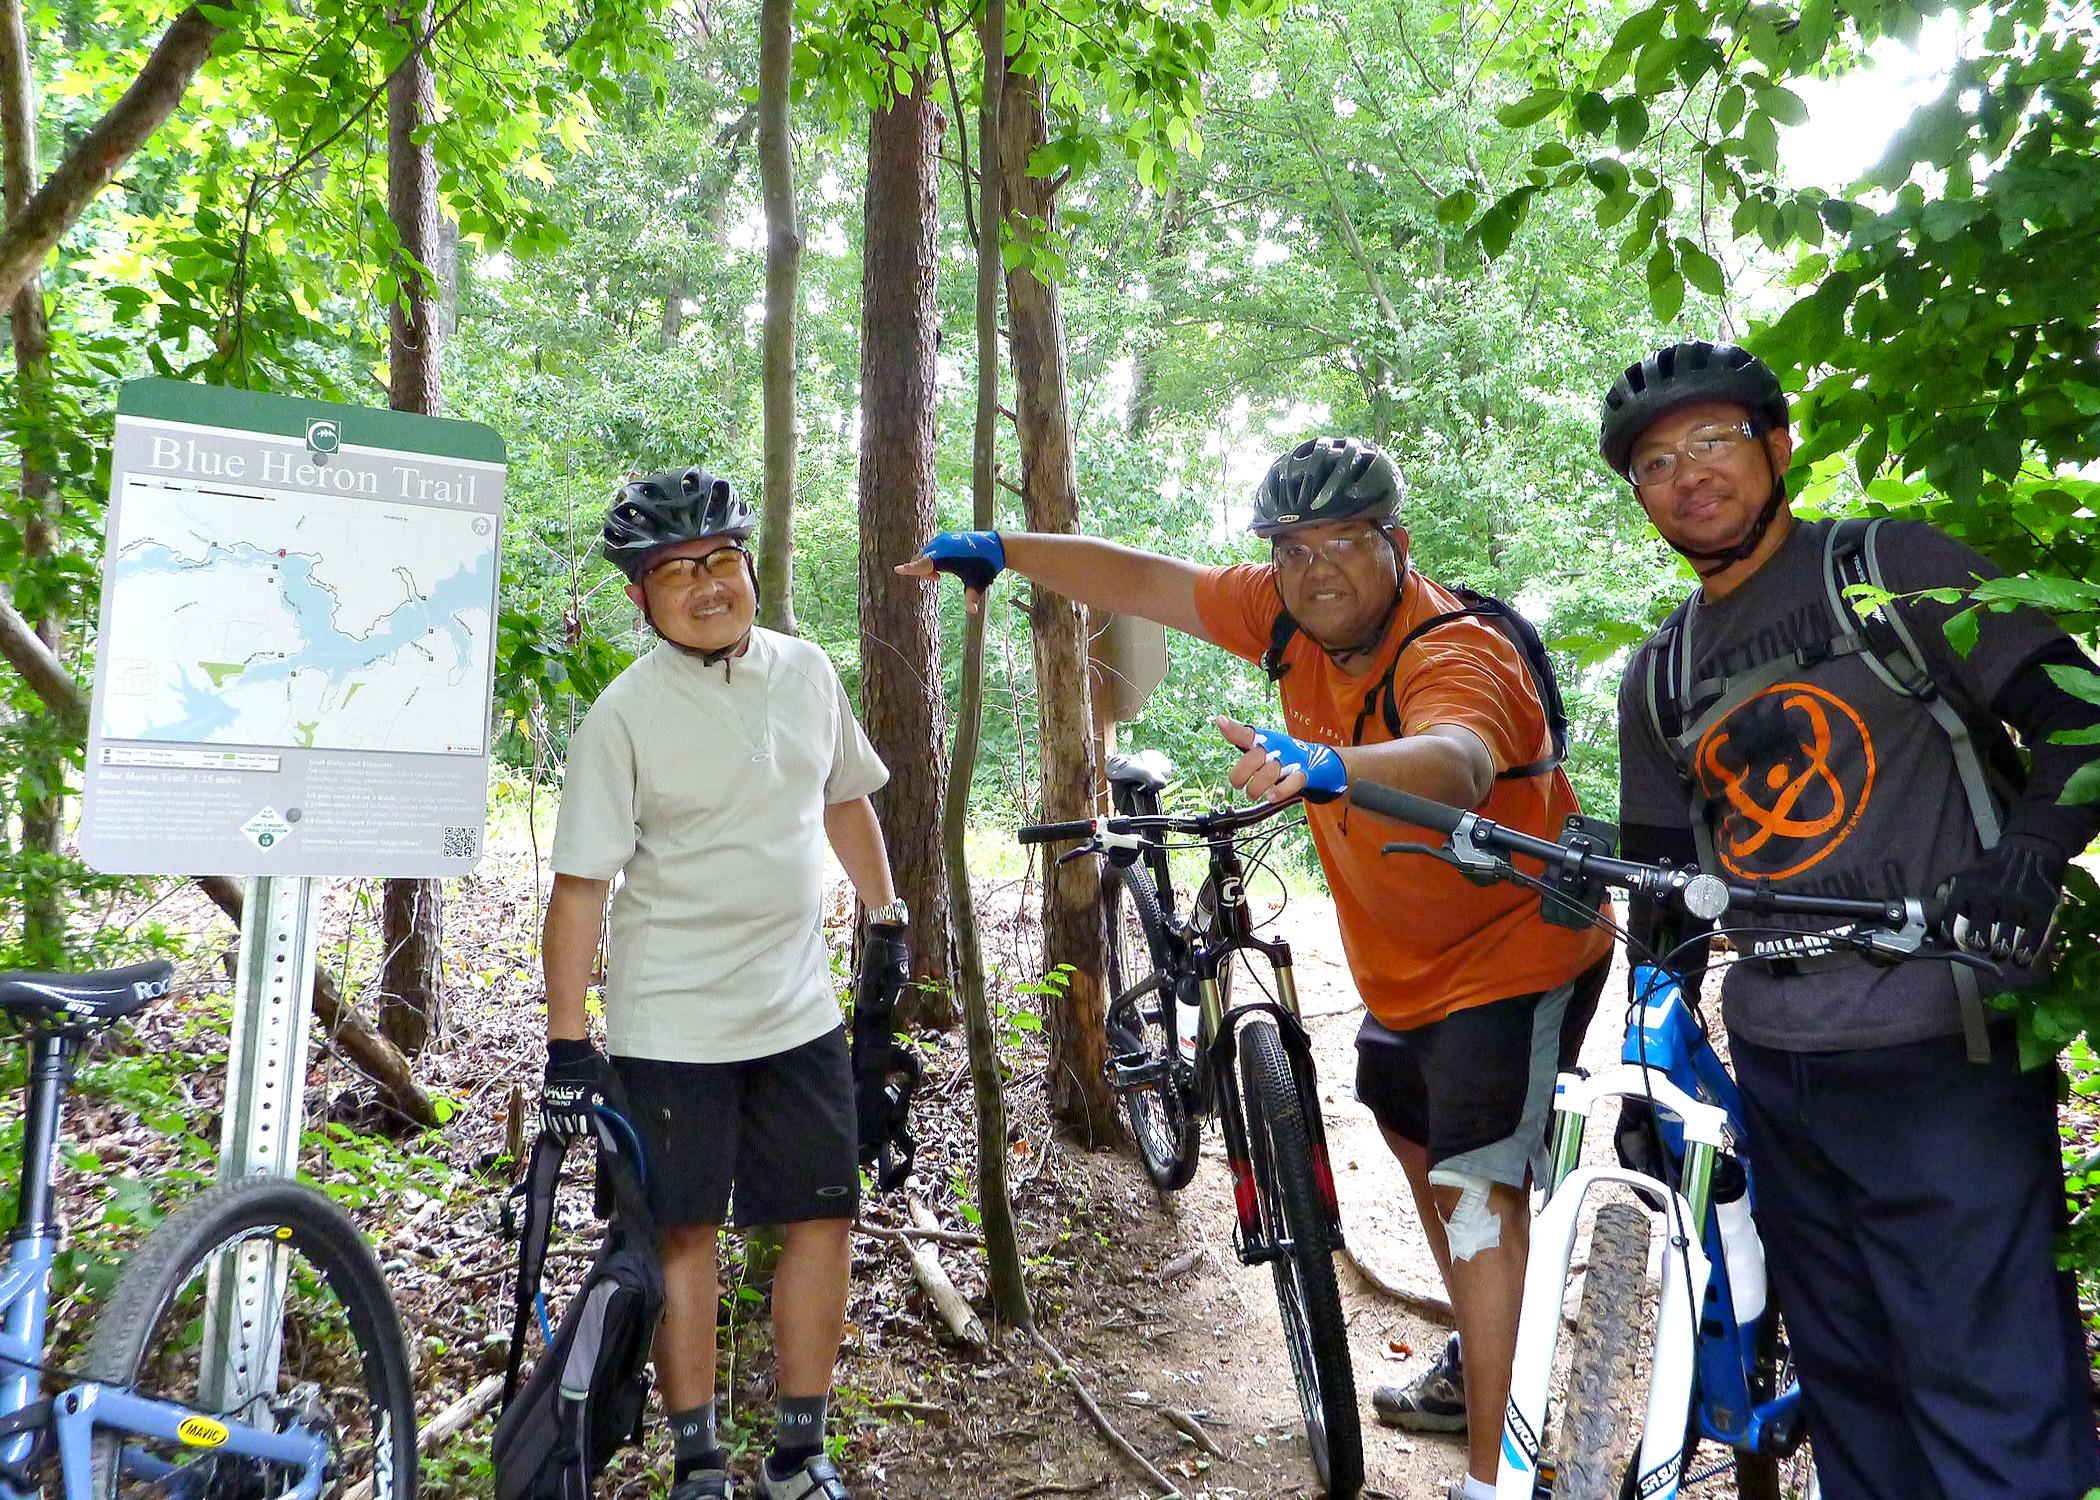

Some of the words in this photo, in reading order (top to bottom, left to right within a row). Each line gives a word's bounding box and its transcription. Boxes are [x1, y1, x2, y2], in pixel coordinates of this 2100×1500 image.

[148, 436, 246, 478] Blue
[260, 448, 379, 494] Heron
[392, 465, 477, 505] Trail
[186, 1423, 219, 1442] MAVIC
